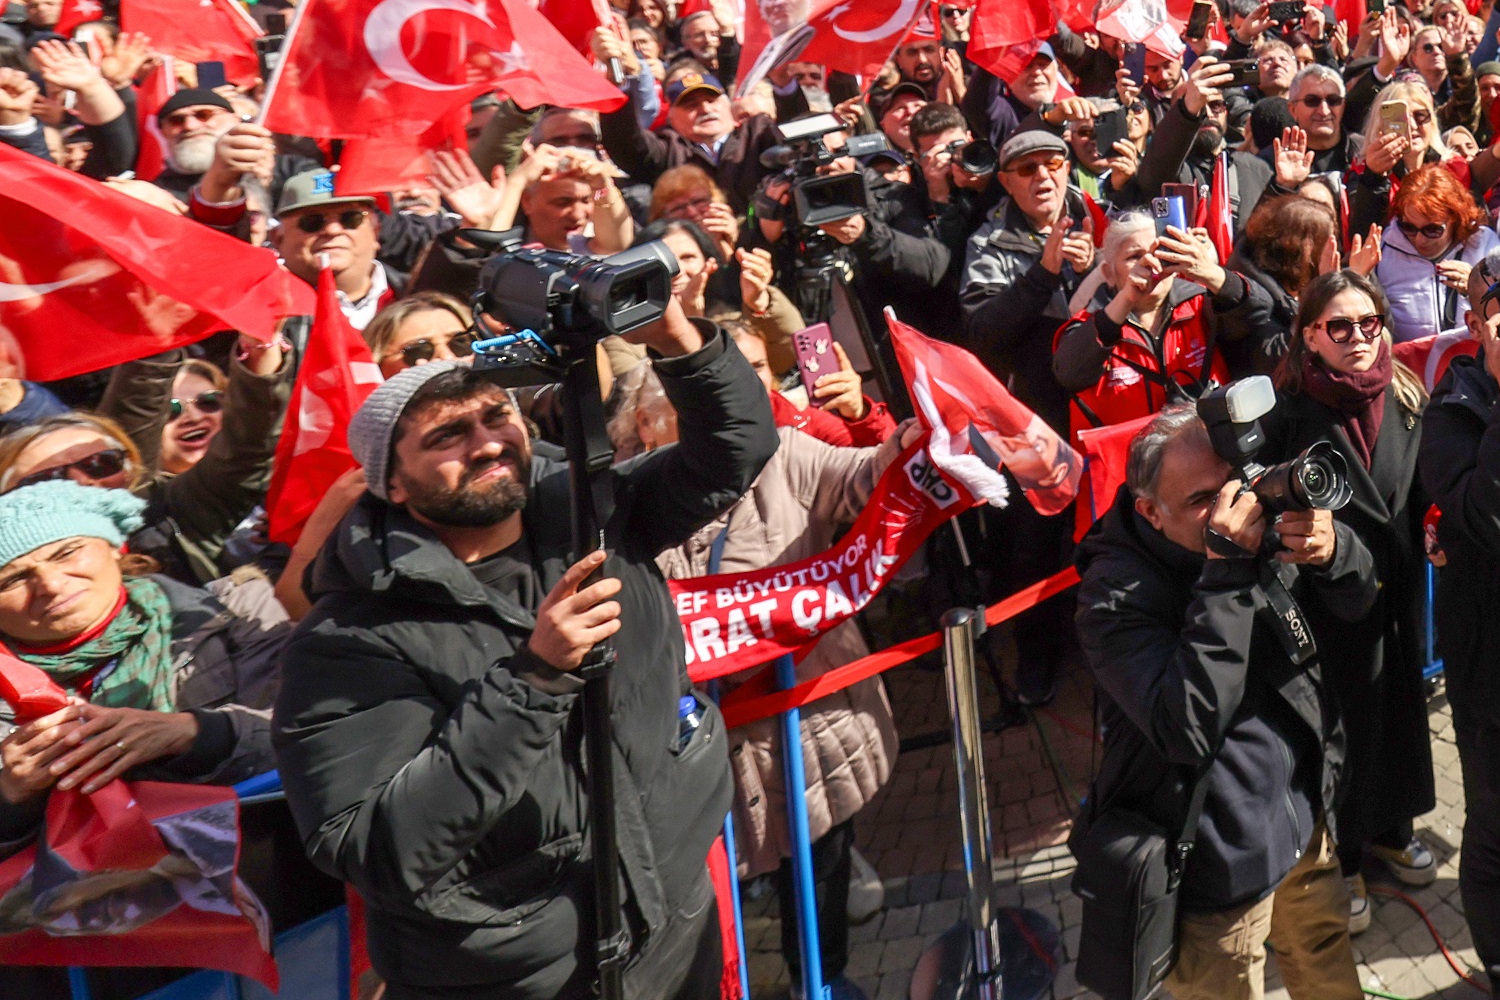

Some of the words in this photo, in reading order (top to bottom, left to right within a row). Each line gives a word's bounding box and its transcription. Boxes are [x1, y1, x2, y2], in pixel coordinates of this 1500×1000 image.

[910, 460, 953, 502] CHP
[672, 590, 708, 616] EF
[715, 533, 868, 609] BÜYÜTÜYOR
[681, 597, 778, 665] RAT
[1284, 606, 1309, 648] SONY
